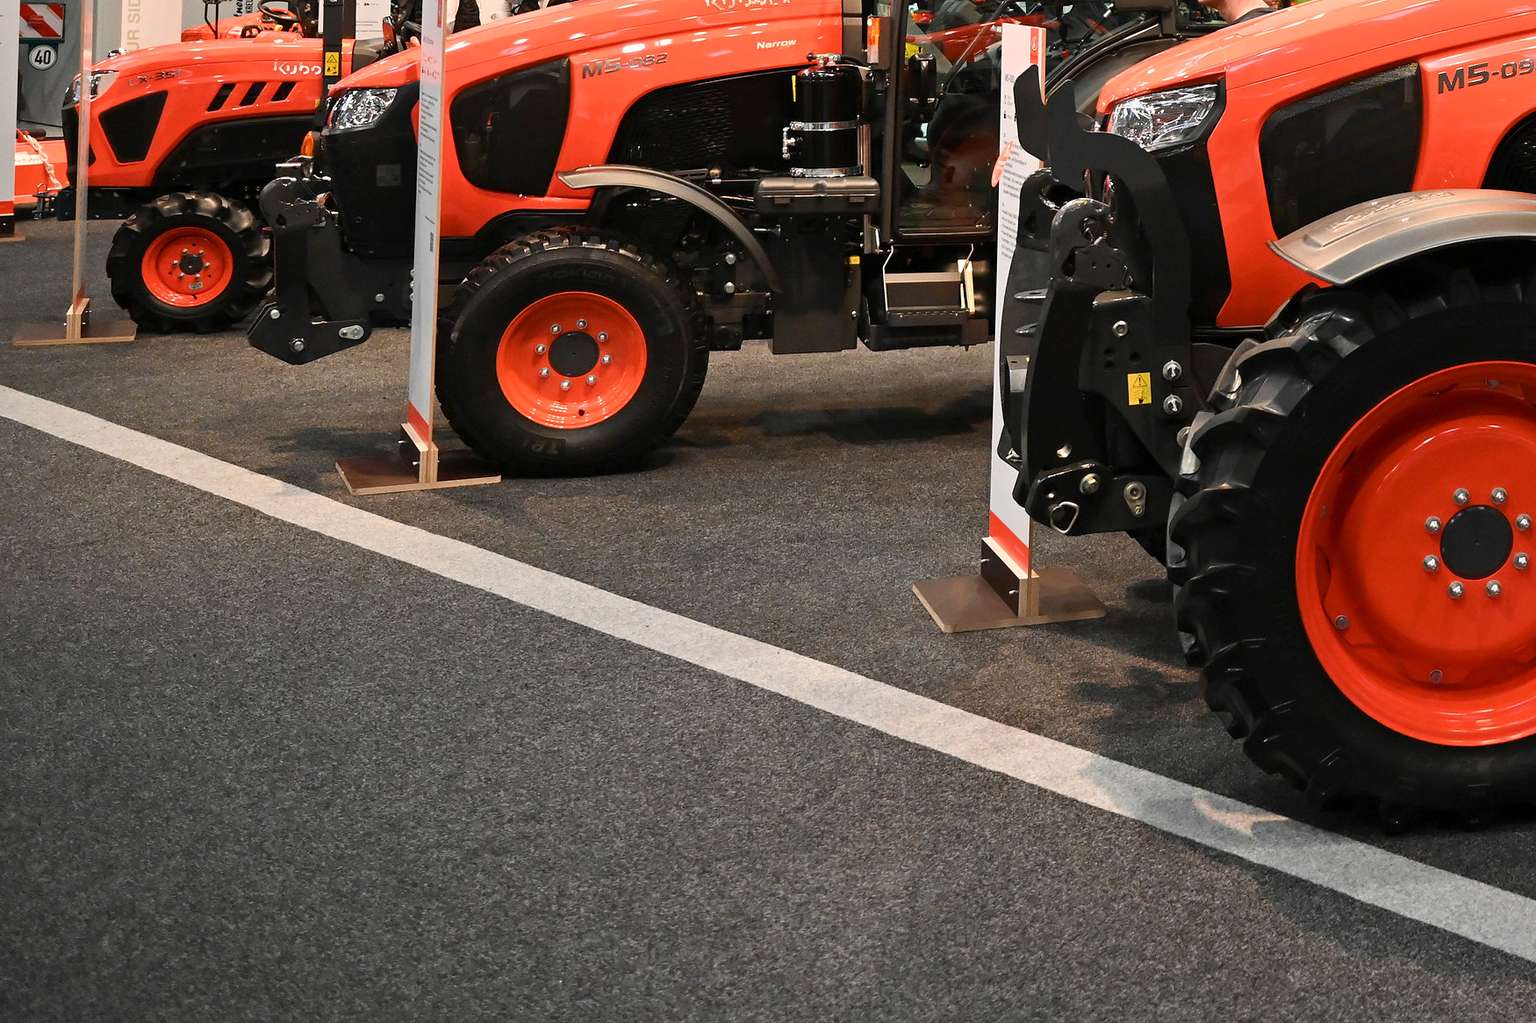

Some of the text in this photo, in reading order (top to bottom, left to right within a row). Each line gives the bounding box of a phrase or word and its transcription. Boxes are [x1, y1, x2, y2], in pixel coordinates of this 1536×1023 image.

[756, 39, 797, 50] Narrow
[34, 50, 51, 65] 40
[273, 60, 322, 75] Kubo
